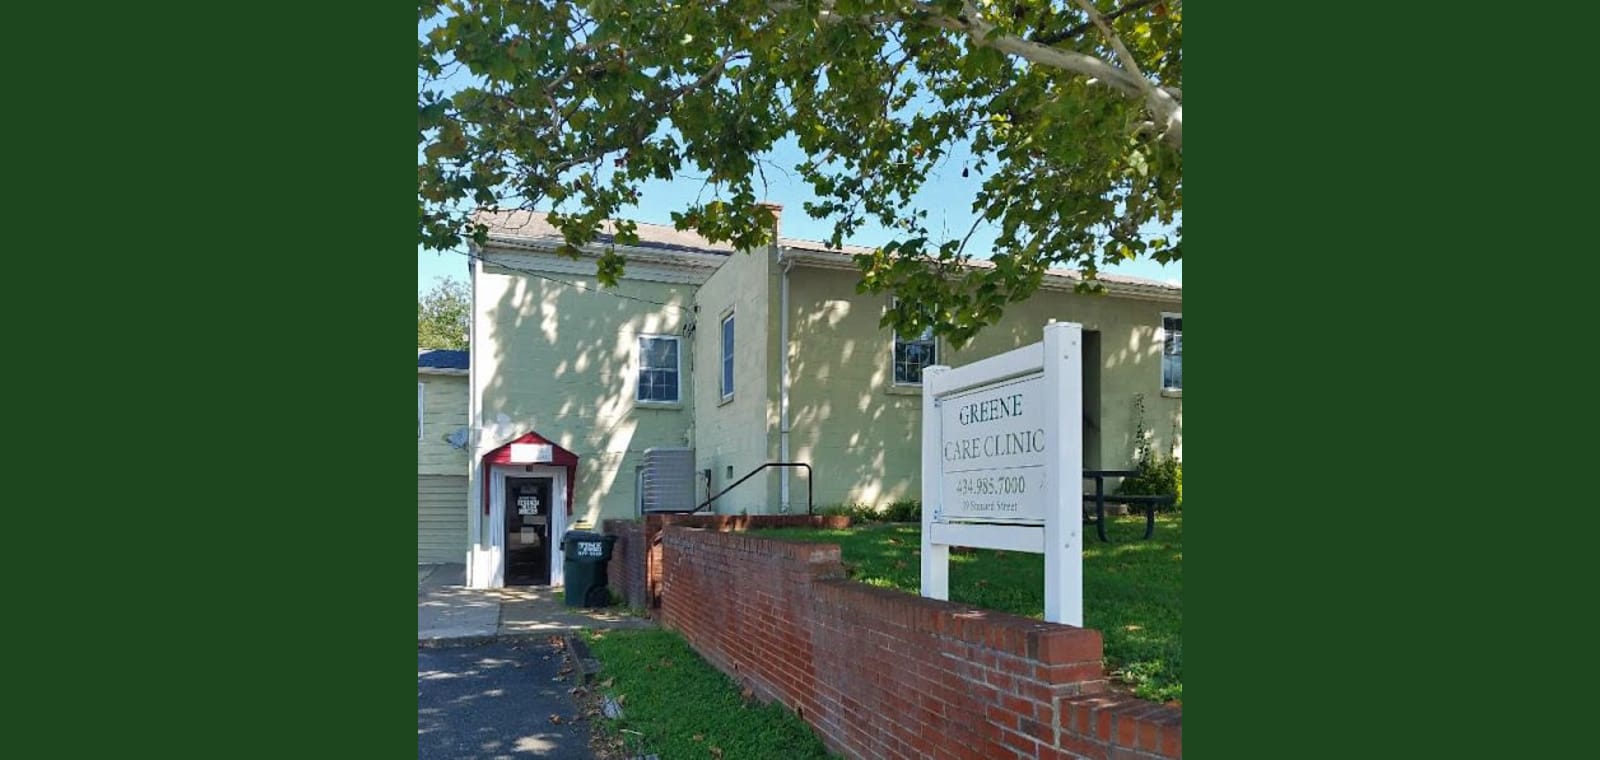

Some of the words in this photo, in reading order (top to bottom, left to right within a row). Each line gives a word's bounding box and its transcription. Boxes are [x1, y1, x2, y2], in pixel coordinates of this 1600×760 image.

[959, 394, 1023, 426] GREENE
[944, 437, 981, 461] CARE
[983, 428, 1045, 458] CLINIC
[956, 475, 1025, 495] 434.985.7000
[997, 500, 1018, 512] Street
